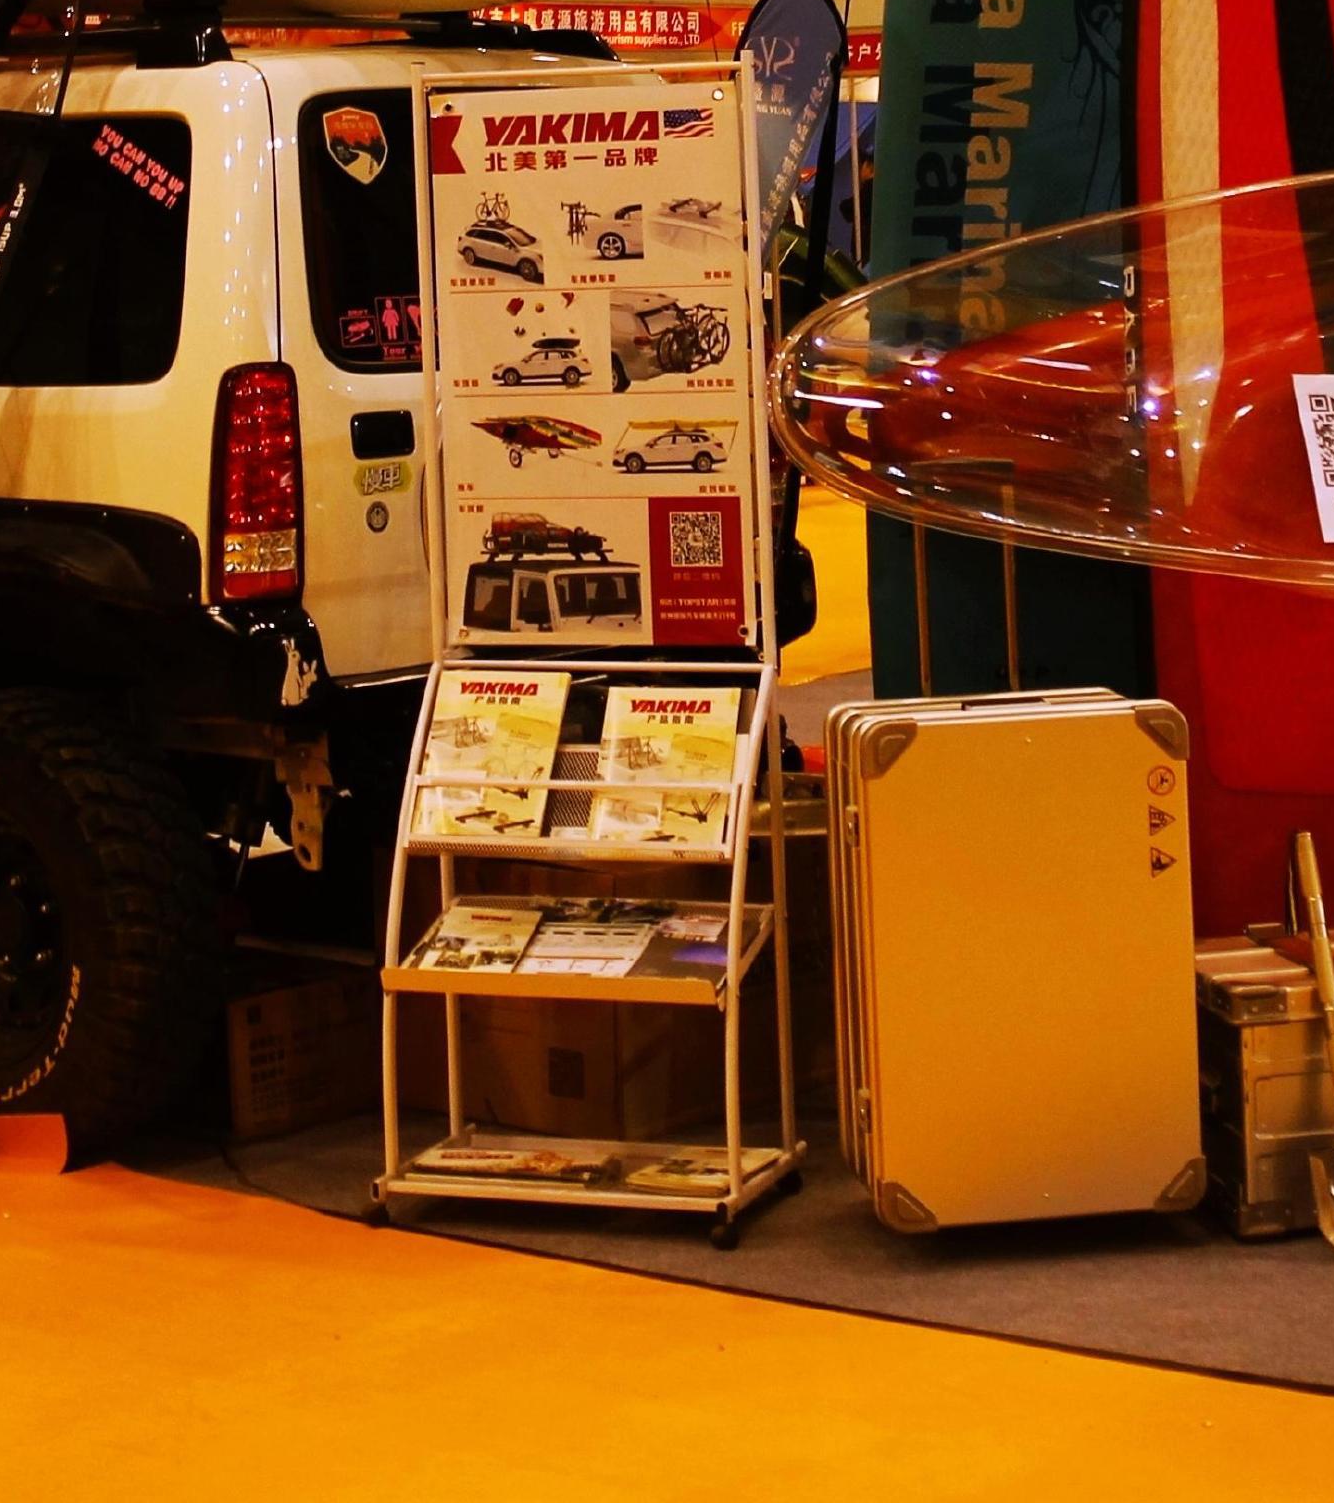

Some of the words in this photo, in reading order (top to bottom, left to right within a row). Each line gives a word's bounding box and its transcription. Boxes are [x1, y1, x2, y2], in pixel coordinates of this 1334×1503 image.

[634, 33, 668, 49] supplies
[483, 110, 660, 147] YAKIMA
[101, 124, 124, 149] YOU
[123, 142, 147, 166] CAN
[146, 157, 169, 183] YOU
[168, 175, 185, 195] UP
[110, 152, 134, 175] CAN
[133, 169, 151, 188] NO
[485, 147, 659, 172] 北美第一品牌
[460, 682, 540, 696] YAKIMA
[630, 699, 713, 715] YAKIMA
